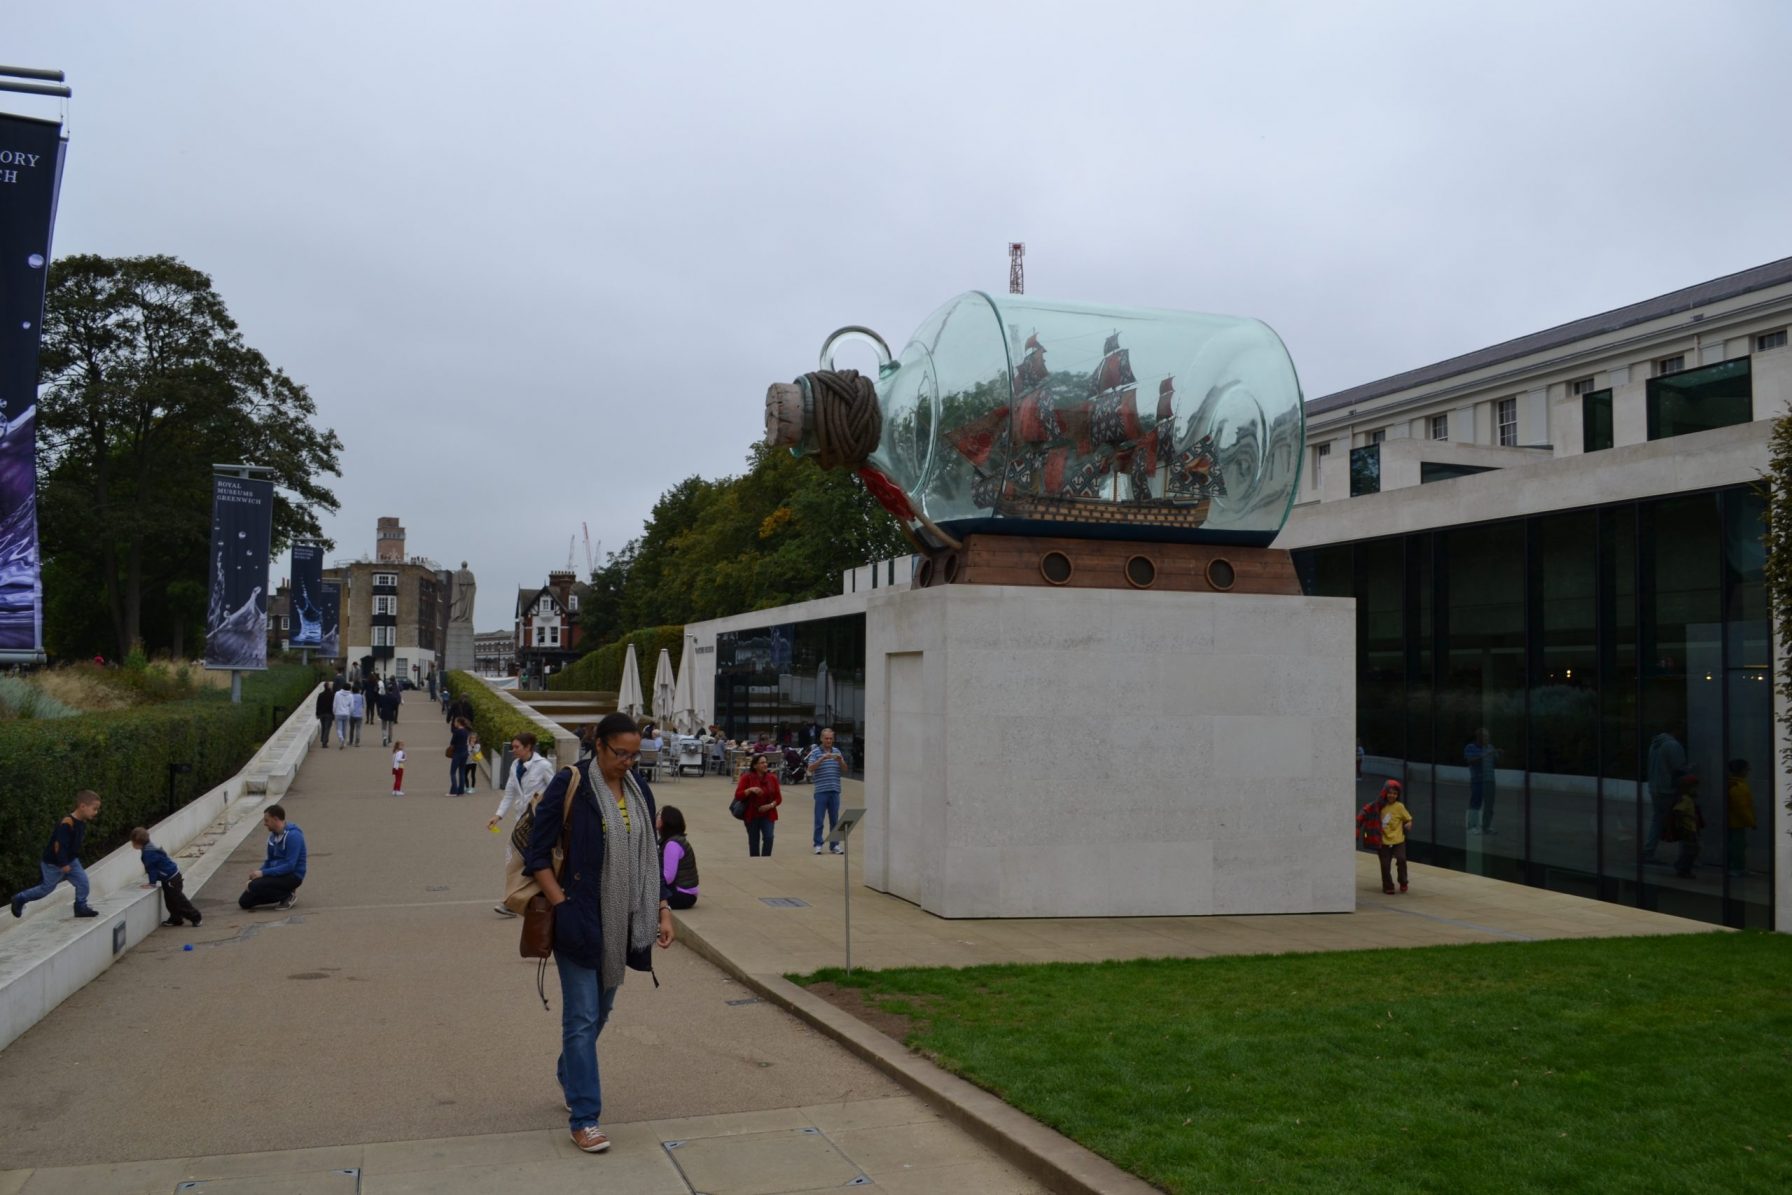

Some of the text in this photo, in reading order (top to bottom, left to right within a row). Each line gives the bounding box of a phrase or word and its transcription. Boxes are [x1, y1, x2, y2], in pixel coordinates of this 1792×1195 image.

[217, 480, 242, 489] ROYAL
[217, 487, 254, 497] MUSEUMS
[216, 494, 261, 505] GREENWICH
